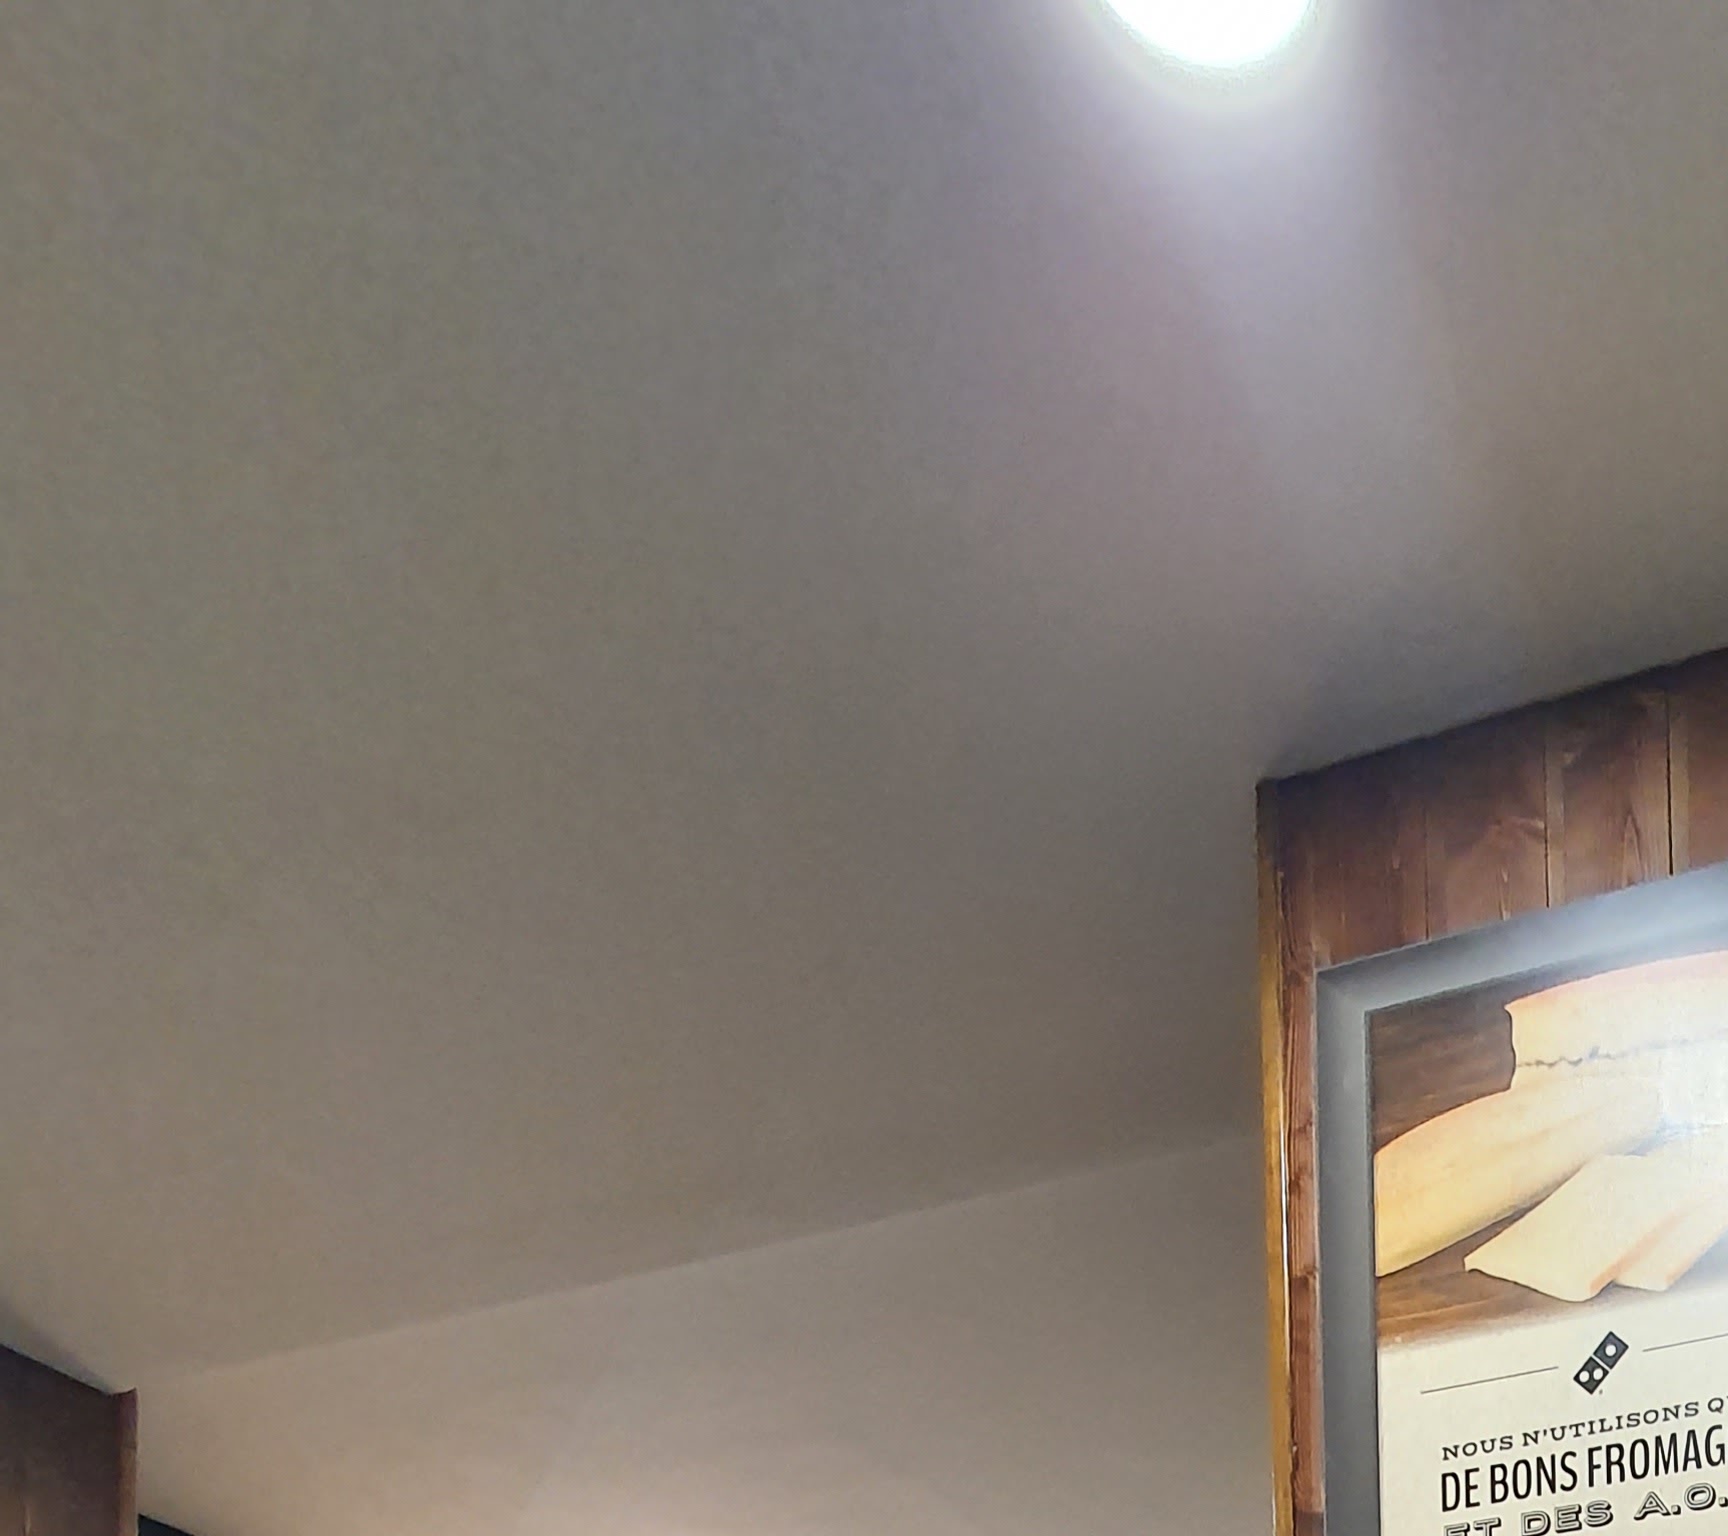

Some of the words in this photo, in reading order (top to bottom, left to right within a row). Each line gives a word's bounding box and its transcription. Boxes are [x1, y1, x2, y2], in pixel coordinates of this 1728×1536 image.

[1441, 1435, 1514, 1460] NOUS
[1522, 1401, 1700, 1447] N'UTILISONS
[1441, 1468, 1480, 1512] DE
[1490, 1451, 1578, 1505] BONS
